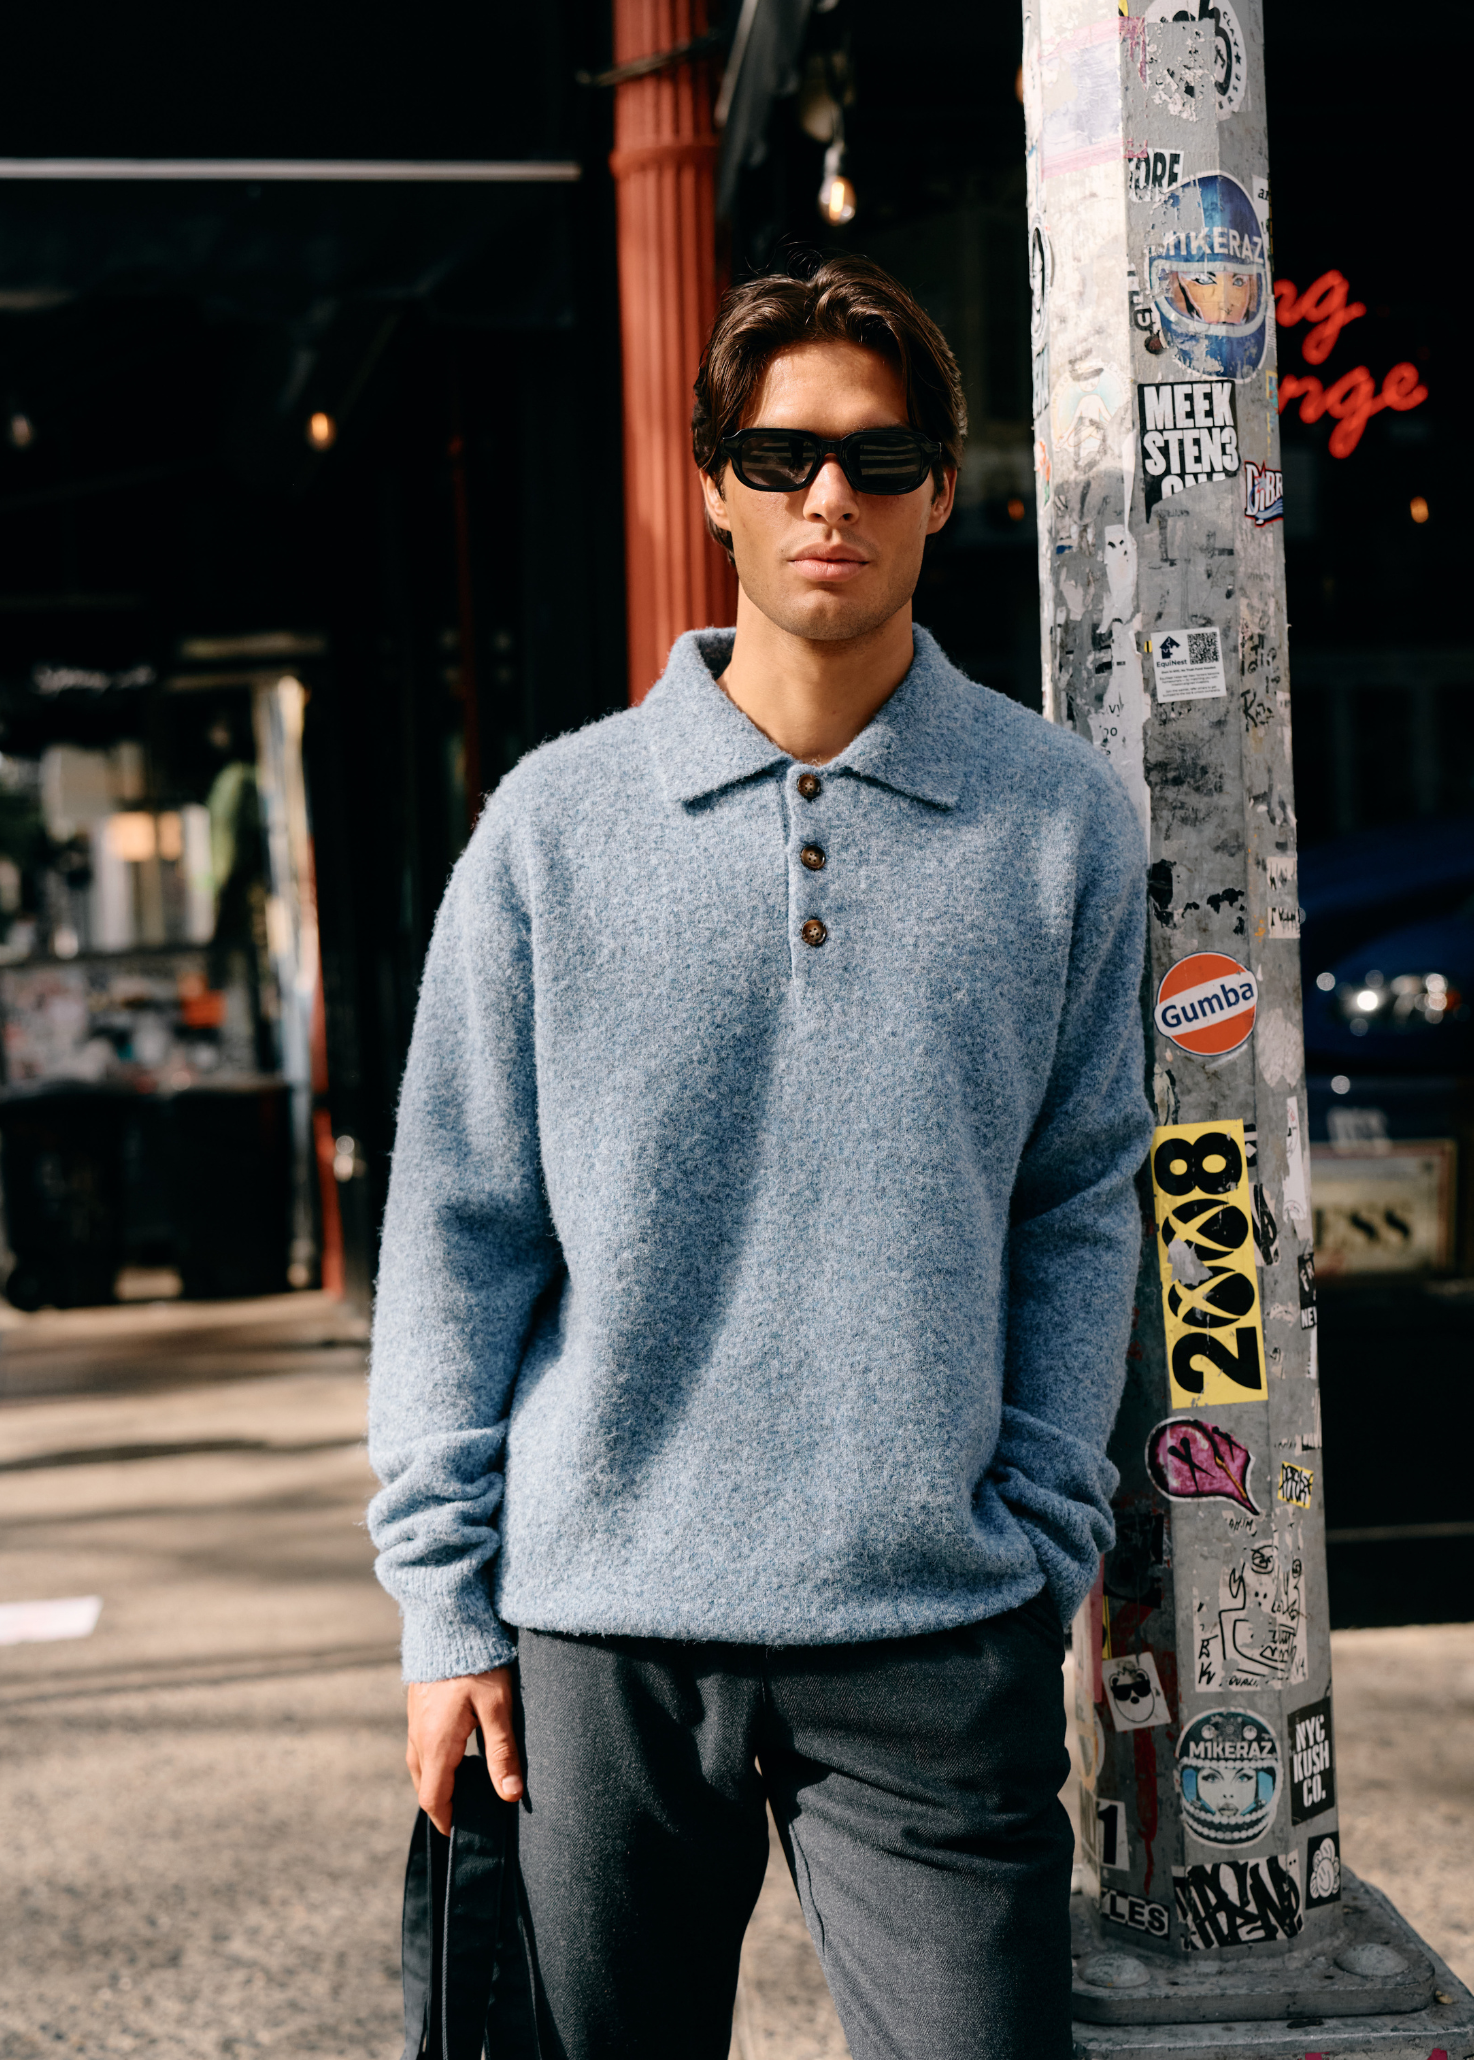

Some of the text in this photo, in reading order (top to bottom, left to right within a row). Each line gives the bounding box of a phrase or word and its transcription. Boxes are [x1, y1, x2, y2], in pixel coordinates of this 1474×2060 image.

[1143, 382, 1234, 431] MEEK
[1143, 426, 1239, 476] STEN3
[1156, 659, 1188, 668] EquiNest
[1160, 981, 1255, 1029] Gumba
[1296, 1714, 1325, 1753] NYC
[1293, 1739, 1330, 1784] KUSH
[1303, 1774, 1326, 1808] CO.
[1101, 1890, 1166, 1933] LES
